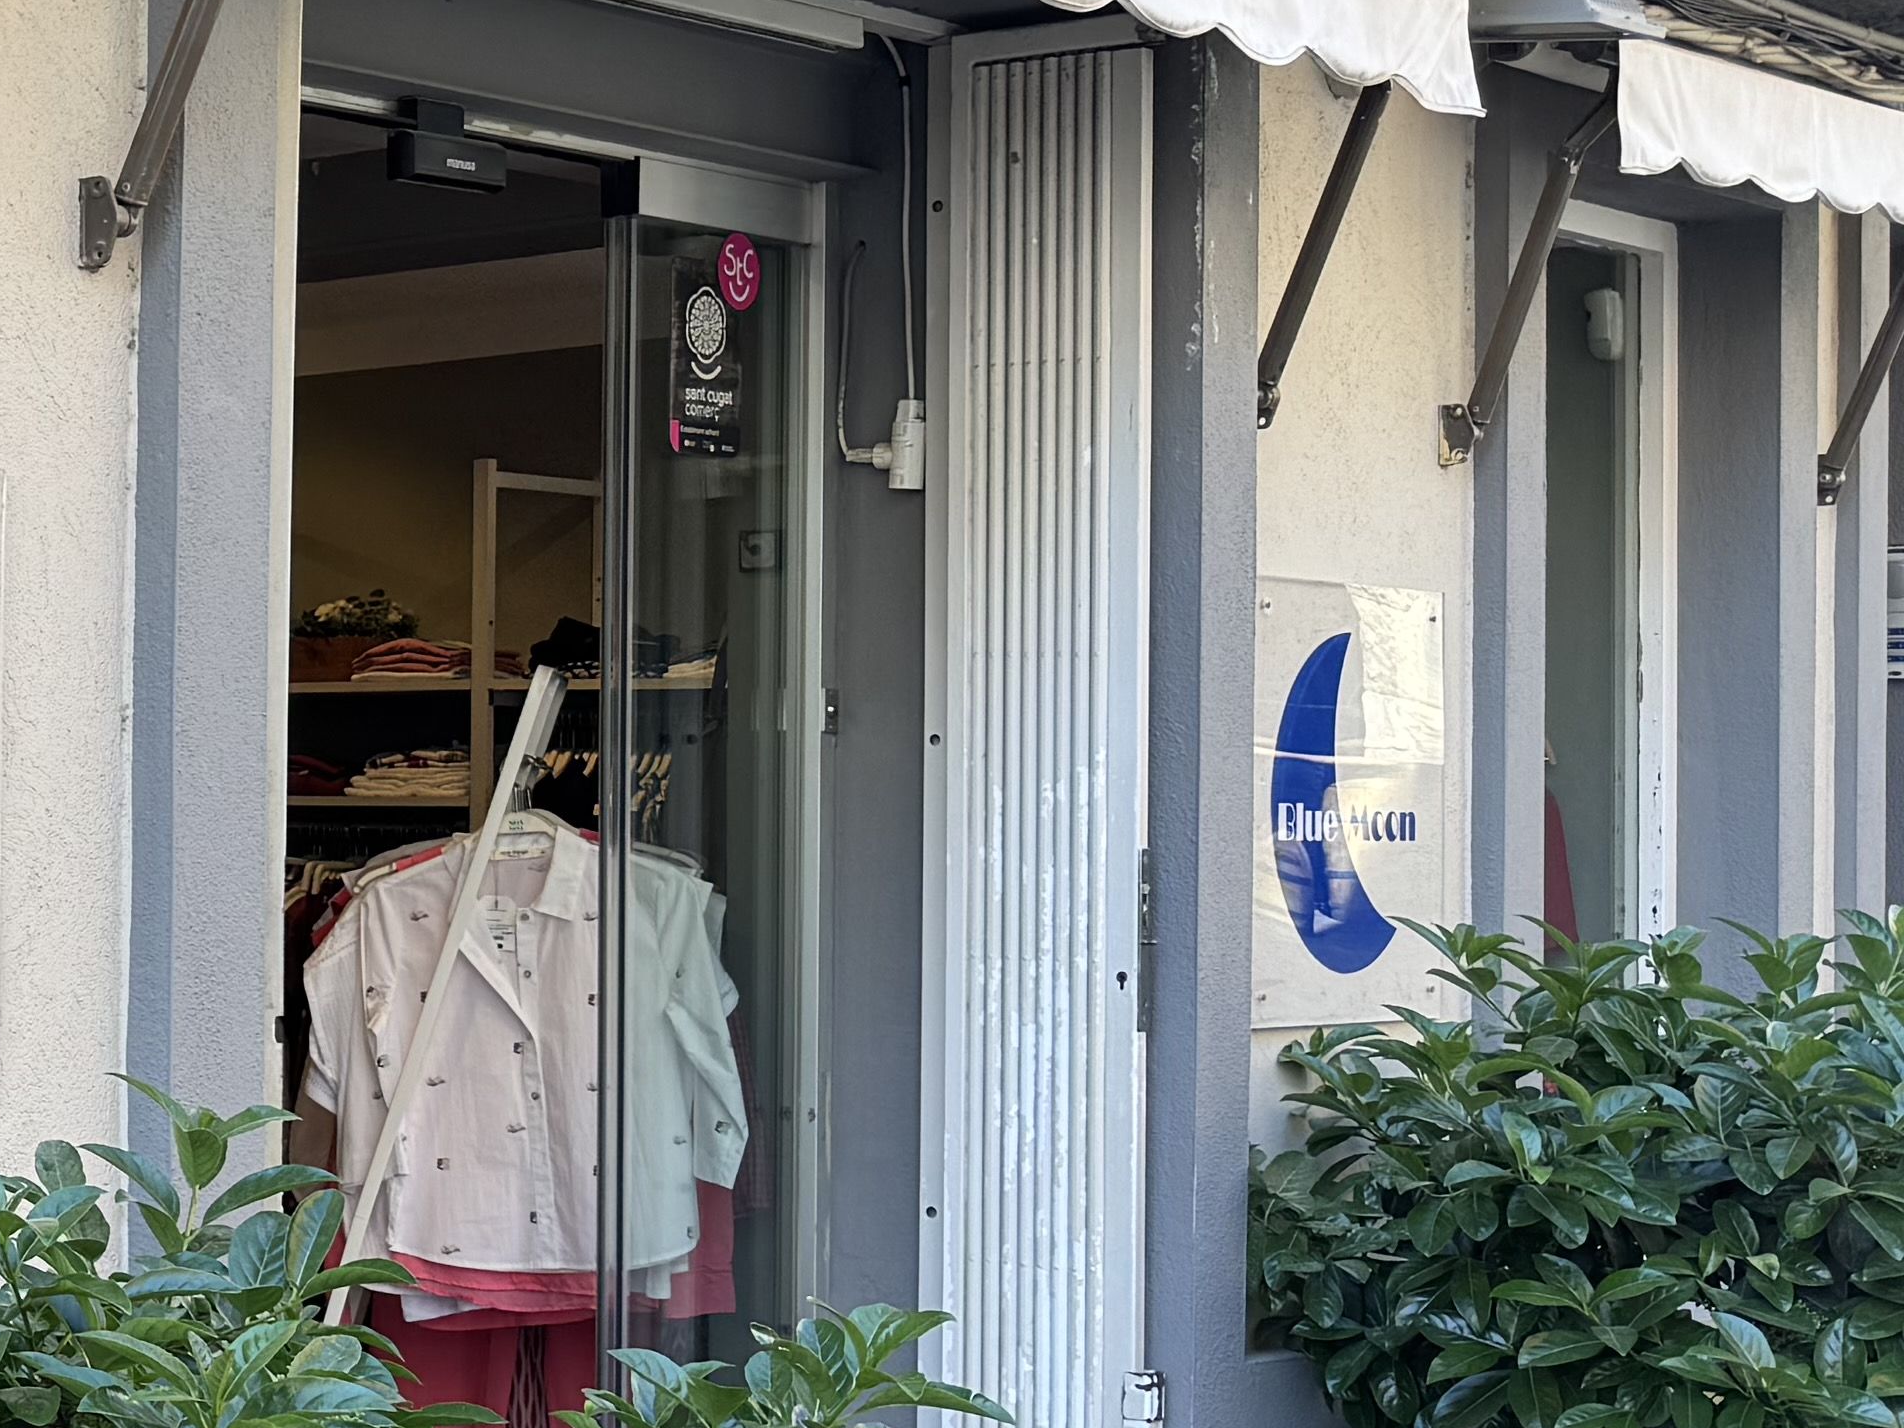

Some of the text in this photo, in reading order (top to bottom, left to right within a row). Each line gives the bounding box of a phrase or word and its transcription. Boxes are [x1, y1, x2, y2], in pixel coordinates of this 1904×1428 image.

[685, 386, 733, 408] sant cugat
[1278, 803, 1416, 842] Blue Moon
